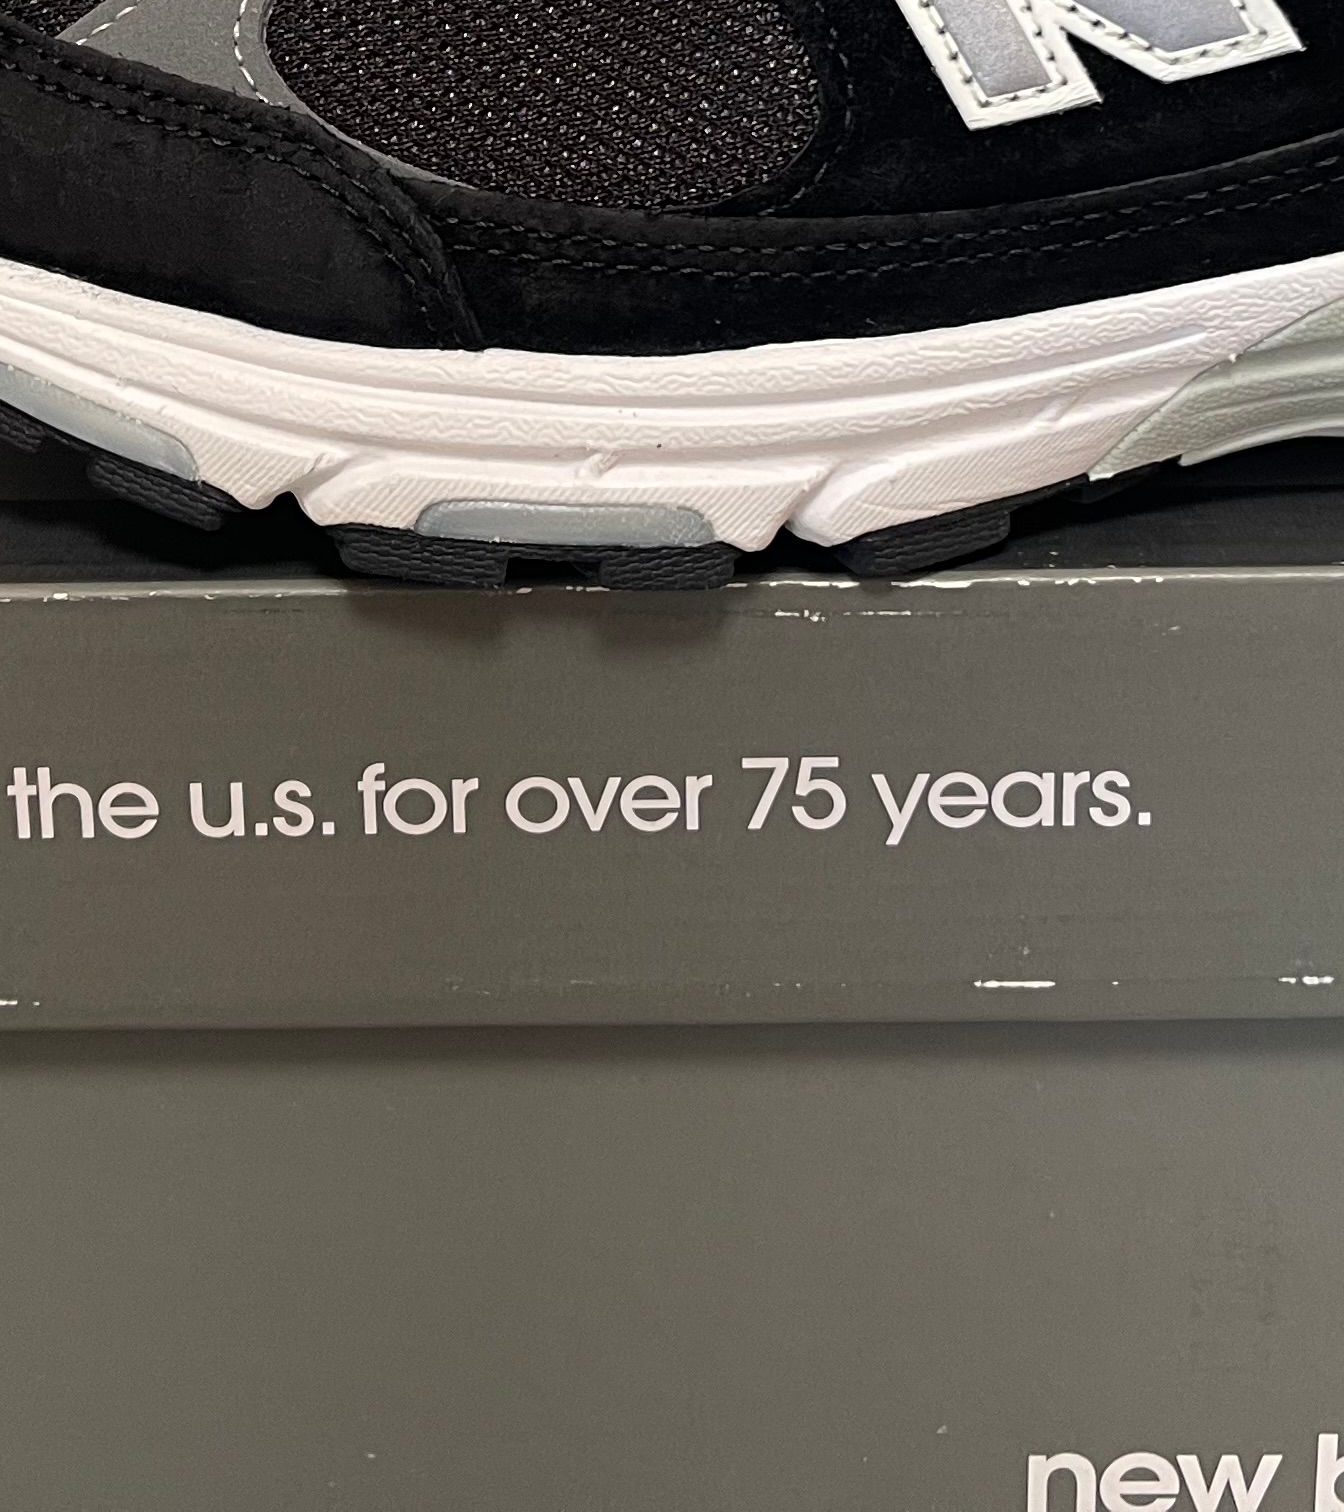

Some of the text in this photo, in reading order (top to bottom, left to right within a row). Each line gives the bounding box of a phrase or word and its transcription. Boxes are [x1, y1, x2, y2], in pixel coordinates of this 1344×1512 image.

[6, 766, 160, 839] the
[188, 779, 336, 838] u.s.
[356, 761, 479, 835] for
[504, 773, 714, 834] over
[740, 756, 848, 830] 75
[870, 769, 1152, 847] years.
[1026, 1451, 1284, 1512] new
